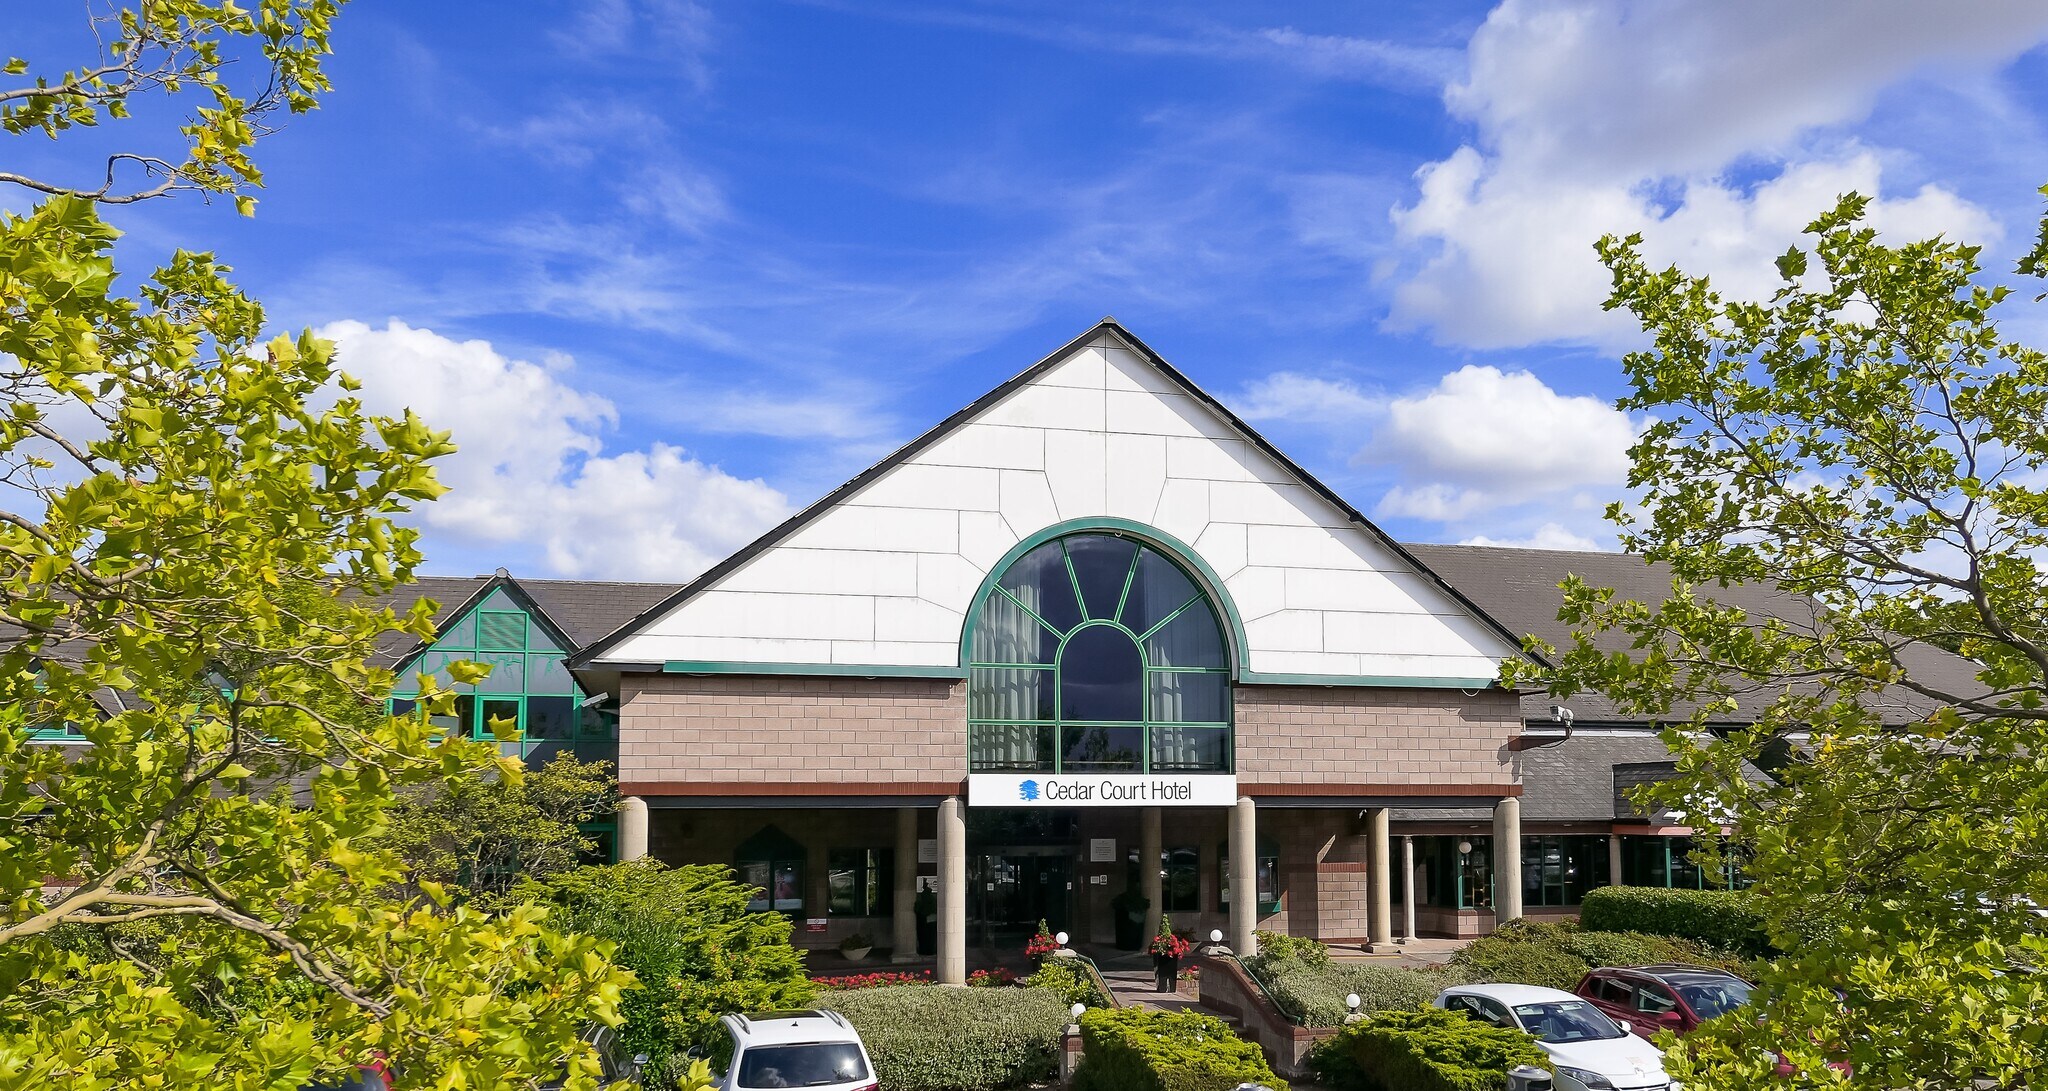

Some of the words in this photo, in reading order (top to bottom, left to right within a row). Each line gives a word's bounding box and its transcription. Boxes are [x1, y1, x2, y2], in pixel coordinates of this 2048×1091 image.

[1045, 780, 1096, 800] Cedar
[1100, 780, 1147, 800] Court
[1151, 780, 1192, 800] Hotel
